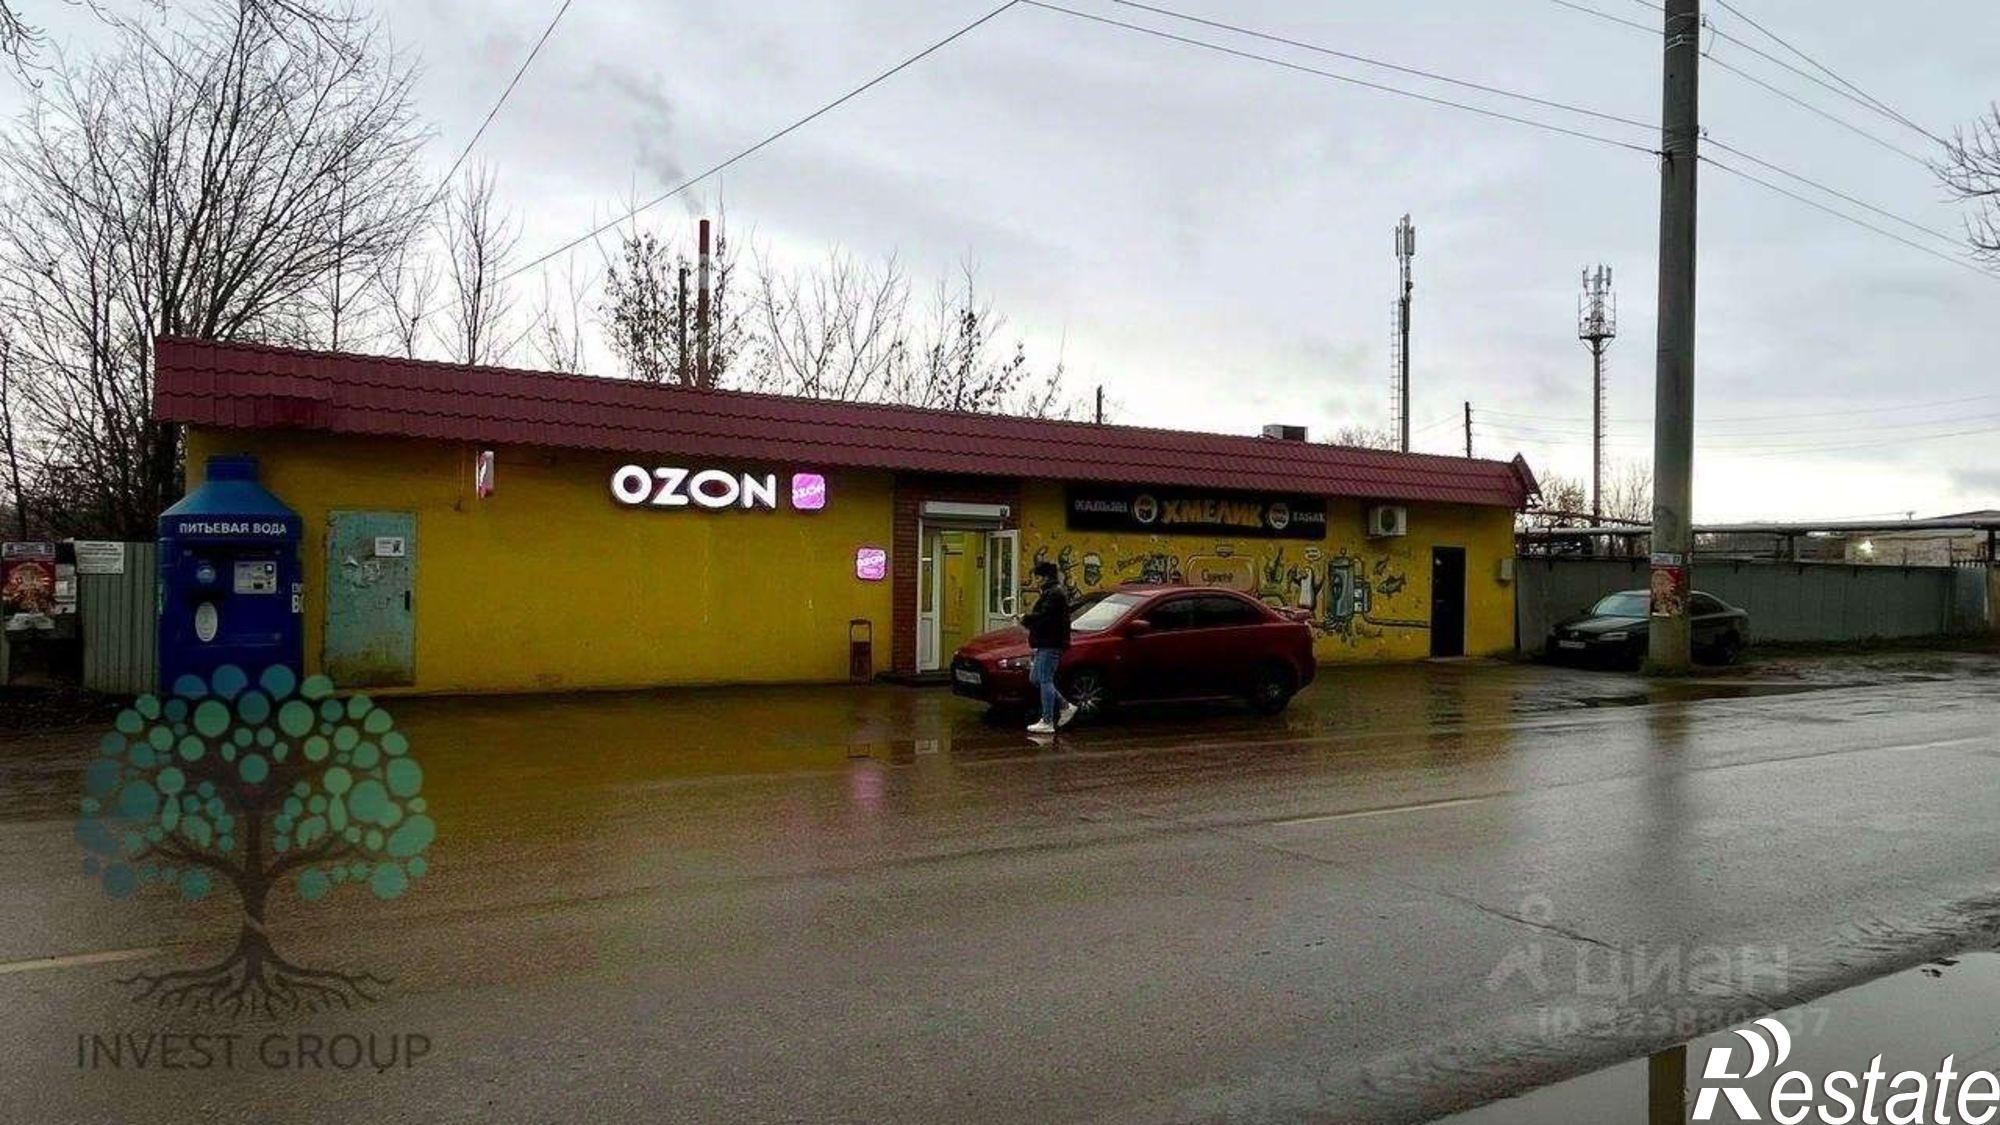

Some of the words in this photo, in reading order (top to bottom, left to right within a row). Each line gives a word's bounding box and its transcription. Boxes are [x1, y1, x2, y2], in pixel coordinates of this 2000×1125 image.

[611, 464, 776, 508] OZON
[179, 522, 249, 534] ПИТЬЕВАЯ
[253, 522, 287, 535] ВОДА
[1160, 498, 1263, 529] ХМЕЛИК
